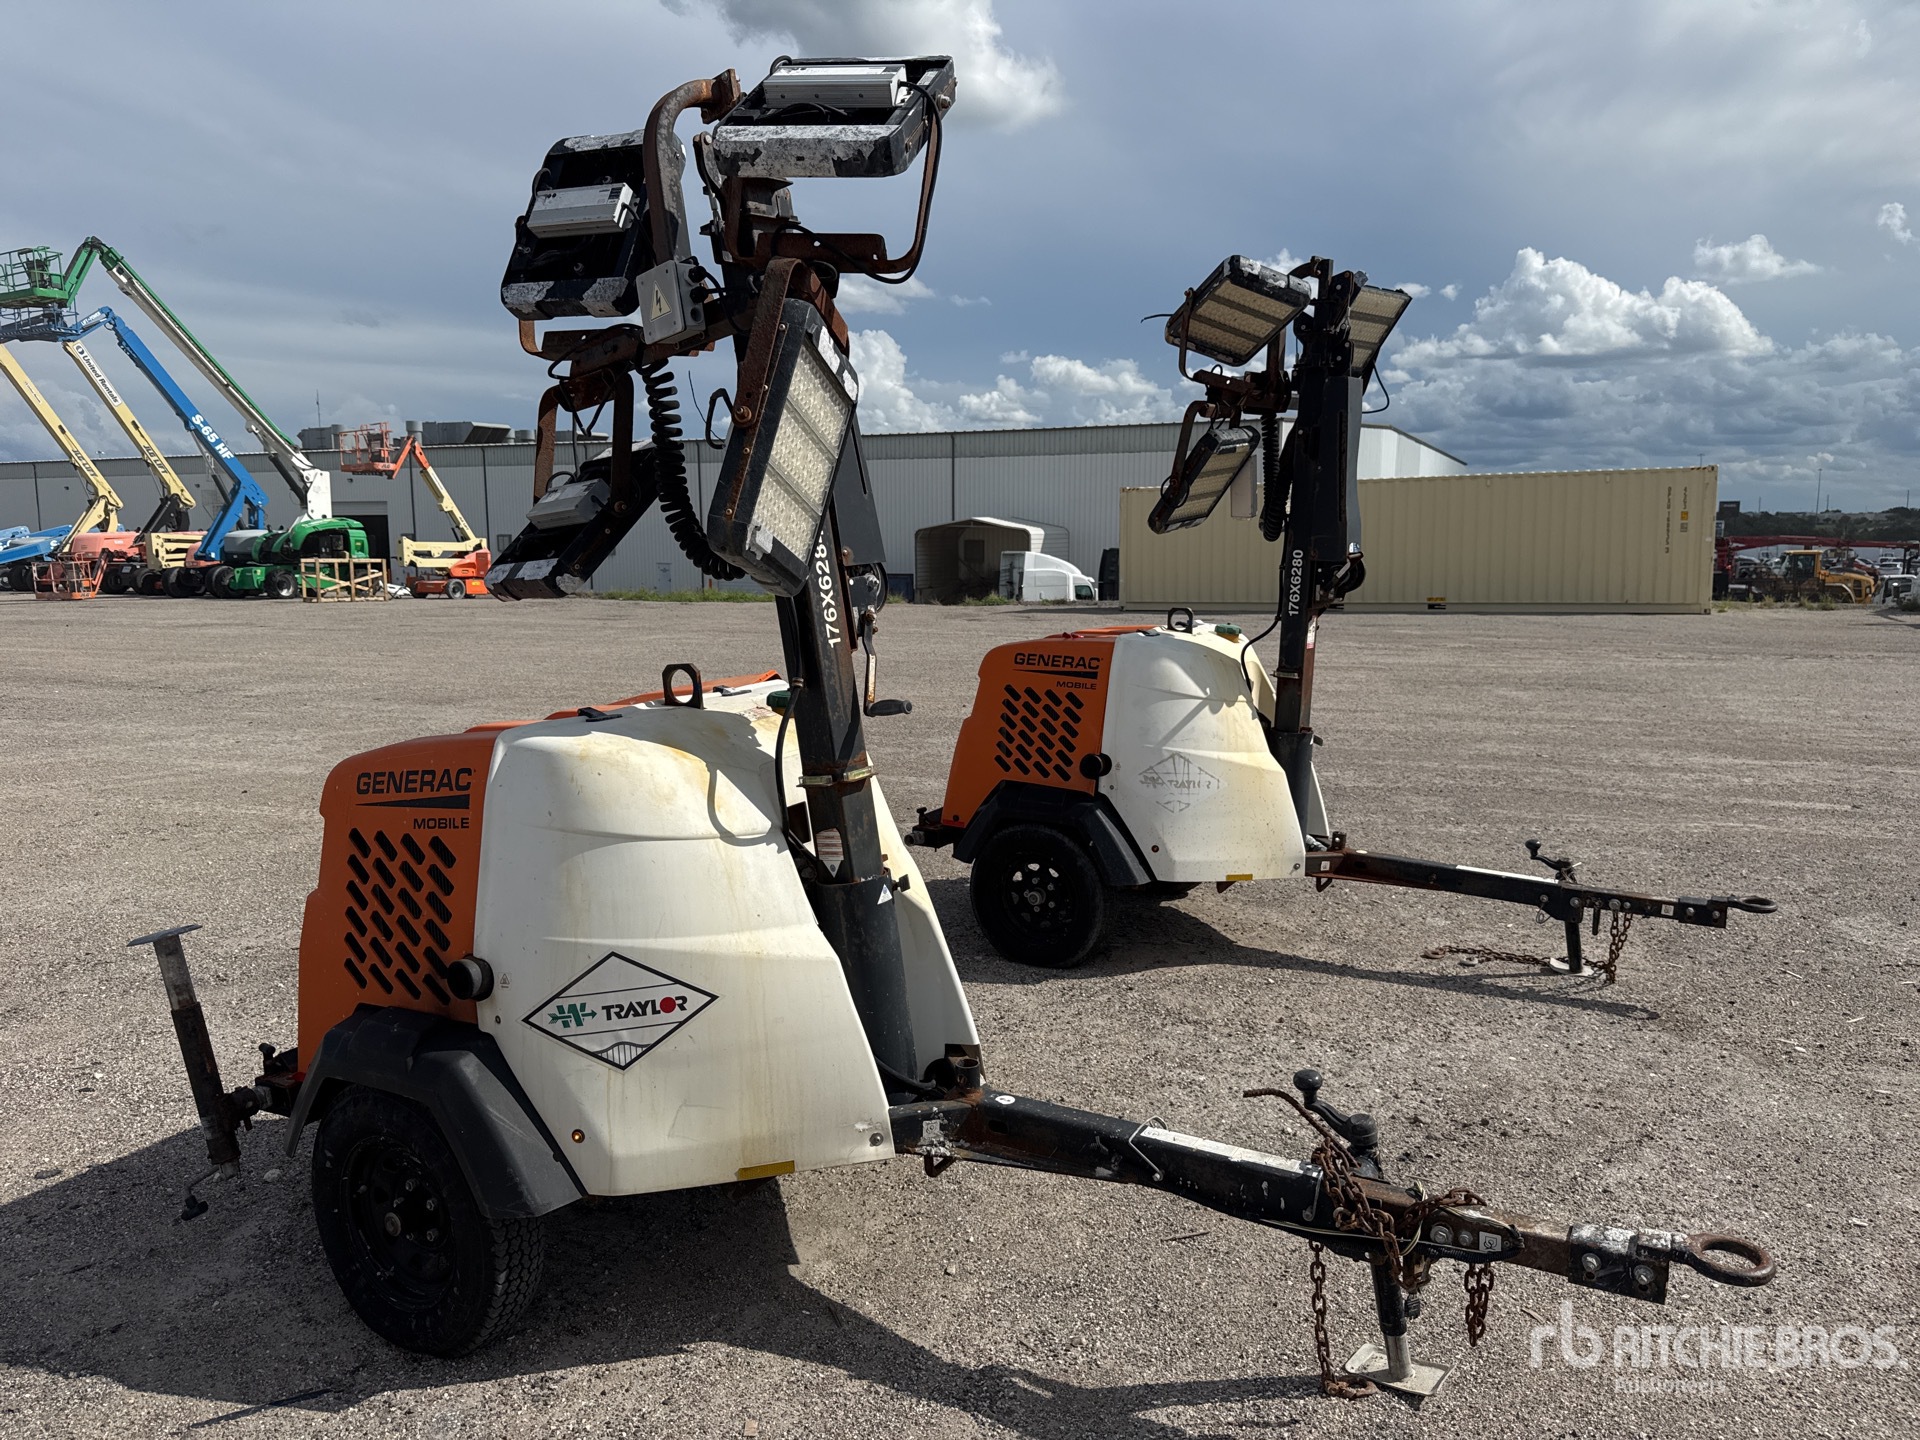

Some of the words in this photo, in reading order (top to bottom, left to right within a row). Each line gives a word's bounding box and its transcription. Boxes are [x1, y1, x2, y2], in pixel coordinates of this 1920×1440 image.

[82, 355, 101, 378] United
[99, 378, 119, 403] Rentals
[191, 414, 219, 443] S-65
[215, 443, 234, 459] HF
[143, 445, 157, 458] JLG
[153, 459, 169, 474] LIFT
[1288, 549, 1304, 616] 176X6280
[1014, 652, 1101, 670] GENERAC
[1056, 681, 1097, 690] MOBILE
[356, 767, 473, 795] GENERAC
[413, 817, 470, 830] MOBILE
[601, 995, 688, 1021] TRAYLOR
